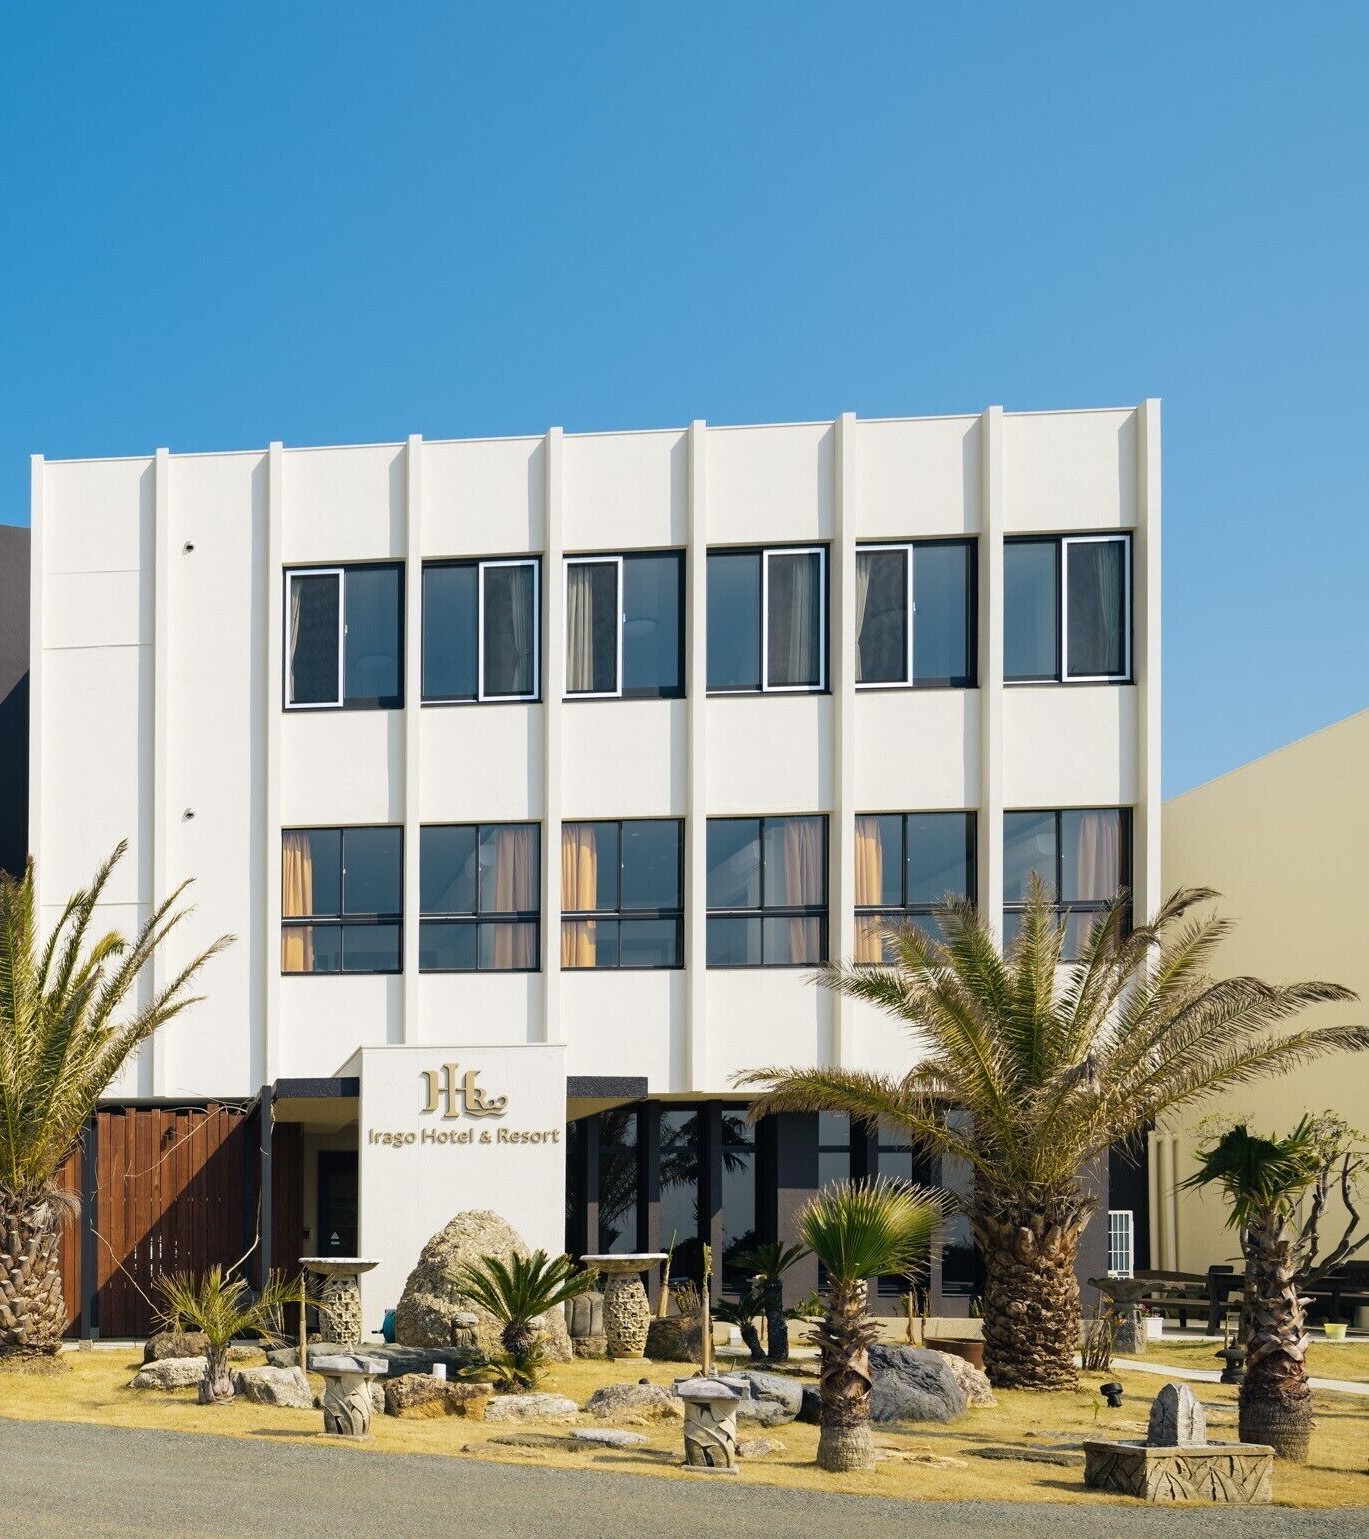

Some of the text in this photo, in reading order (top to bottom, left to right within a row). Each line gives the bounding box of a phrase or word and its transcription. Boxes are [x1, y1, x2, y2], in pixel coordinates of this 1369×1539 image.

[369, 1126, 561, 1148] Irago Hotel & Resort
